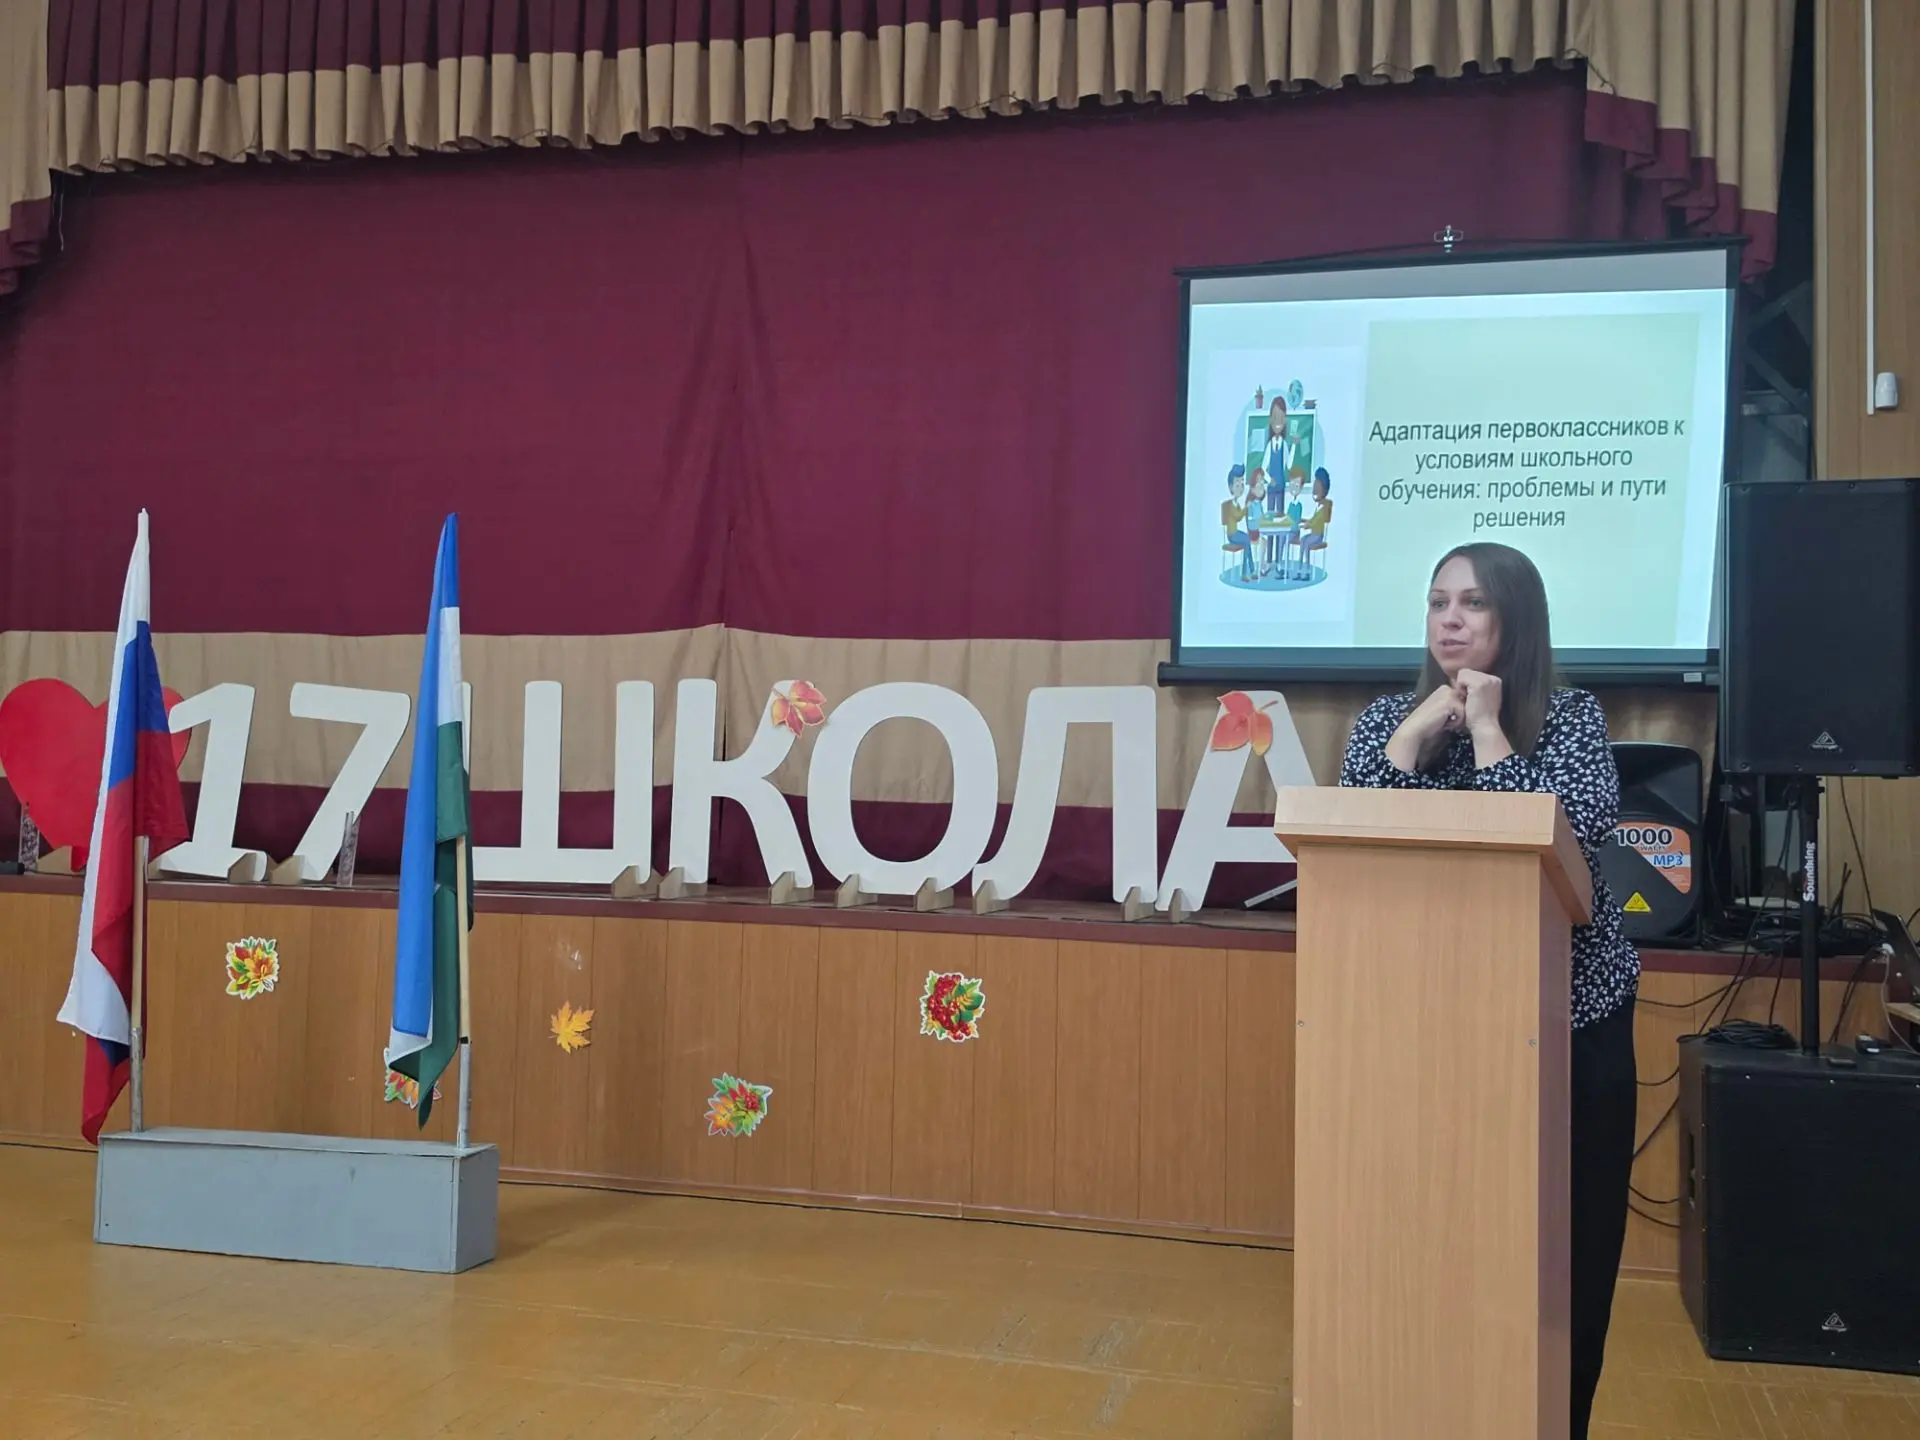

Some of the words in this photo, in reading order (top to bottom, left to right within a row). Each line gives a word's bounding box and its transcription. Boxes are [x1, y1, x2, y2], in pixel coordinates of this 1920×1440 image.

[1369, 421, 1482, 443] Адаптация
[1488, 419, 1668, 442] первоклассников
[1674, 420, 1685, 435] к
[1415, 451, 1514, 474] условиям
[1521, 449, 1633, 467] школьного
[1378, 479, 1481, 504] обучения:
[1488, 476, 1594, 502] проблемы
[1601, 480, 1613, 496] и
[1620, 479, 1666, 501] пути
[1473, 510, 1565, 532] решения
[158, 682, 411, 881] 17
[461, 678, 1318, 911] ШКОЛА
[1615, 827, 1673, 846] 1000
[1653, 854, 1684, 866] MP3
[1803, 841, 1815, 902] Soundking
